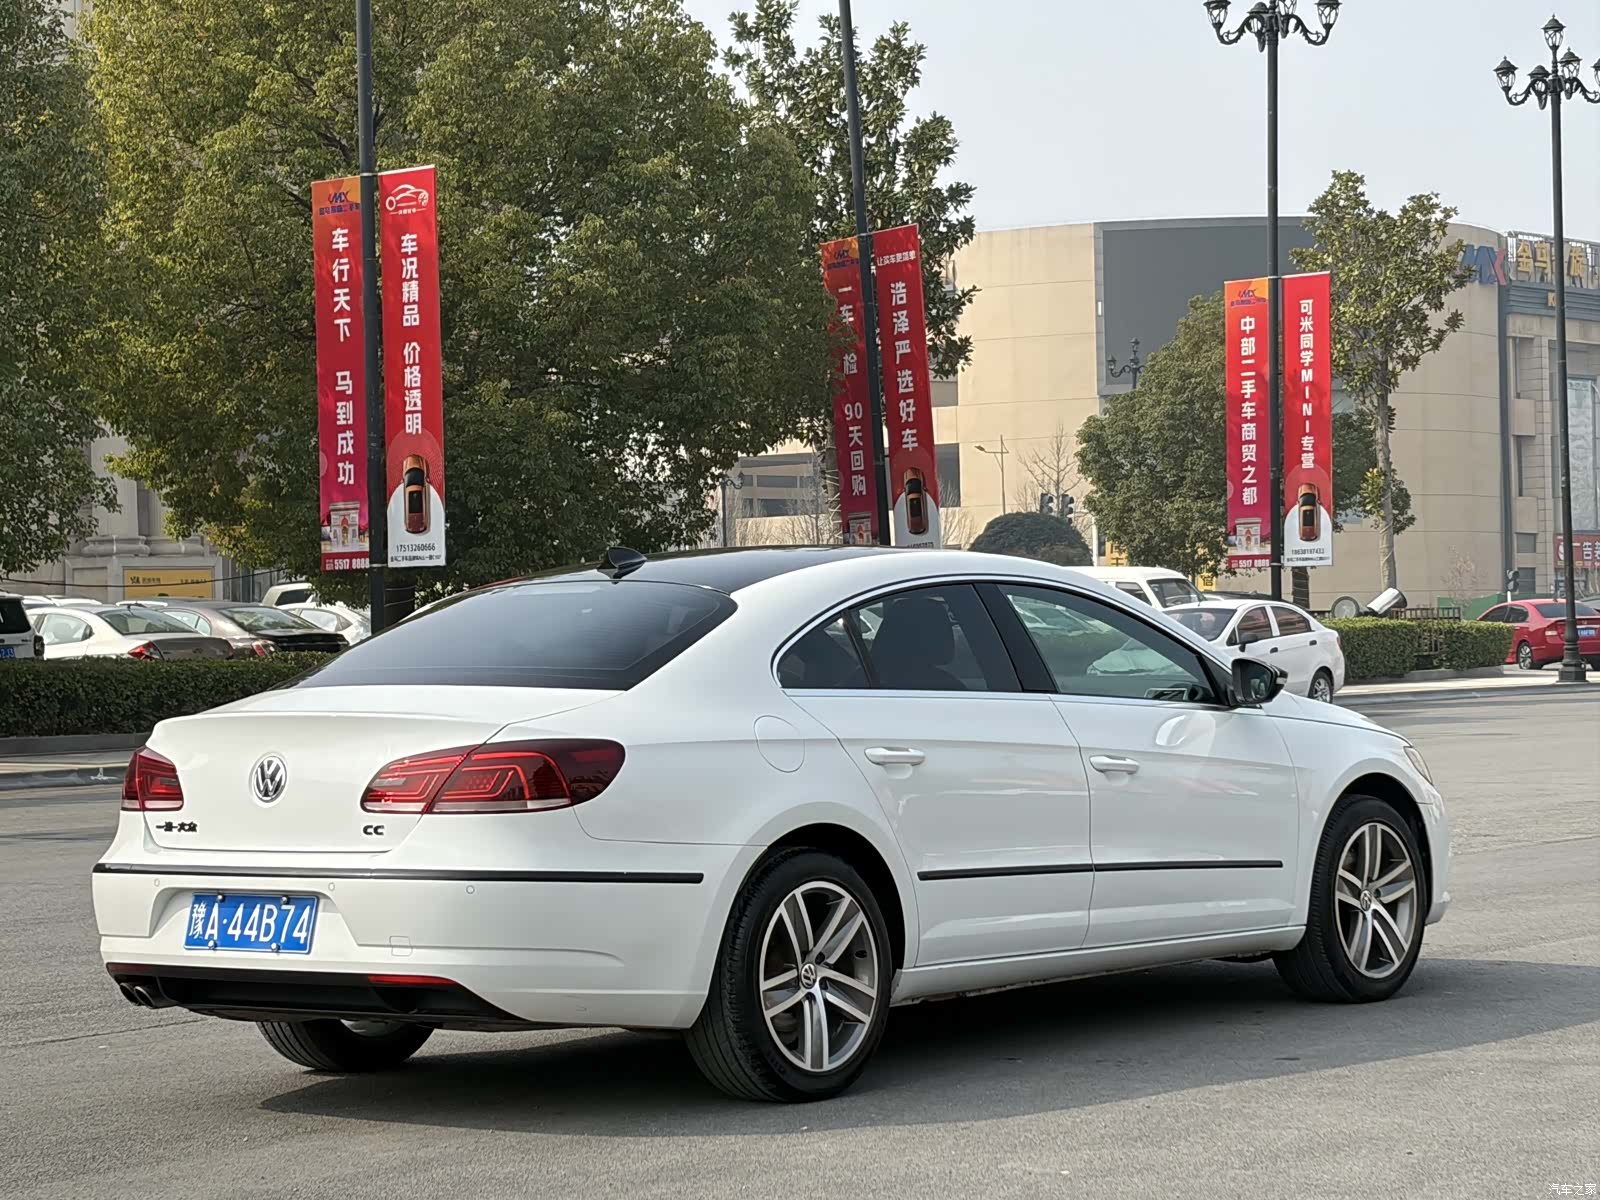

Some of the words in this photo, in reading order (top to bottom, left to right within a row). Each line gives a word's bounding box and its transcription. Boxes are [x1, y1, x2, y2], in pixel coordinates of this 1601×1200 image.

[331, 228, 352, 342] 车行天下
[400, 233, 420, 327] 车况精品
[838, 285, 858, 375] 一车检
[890, 281, 919, 452] 浩泽严选好车
[335, 370, 355, 485] 马到成功
[403, 342, 423, 435] 价格透明
[1240, 315, 1257, 505] 中部二手车商贸之都
[1299, 299, 1315, 469] 可米同学MINI专营
[844, 402, 867, 496] 90天回购
[334, 558, 350, 570] 5517
[363, 825, 384, 836] CC
